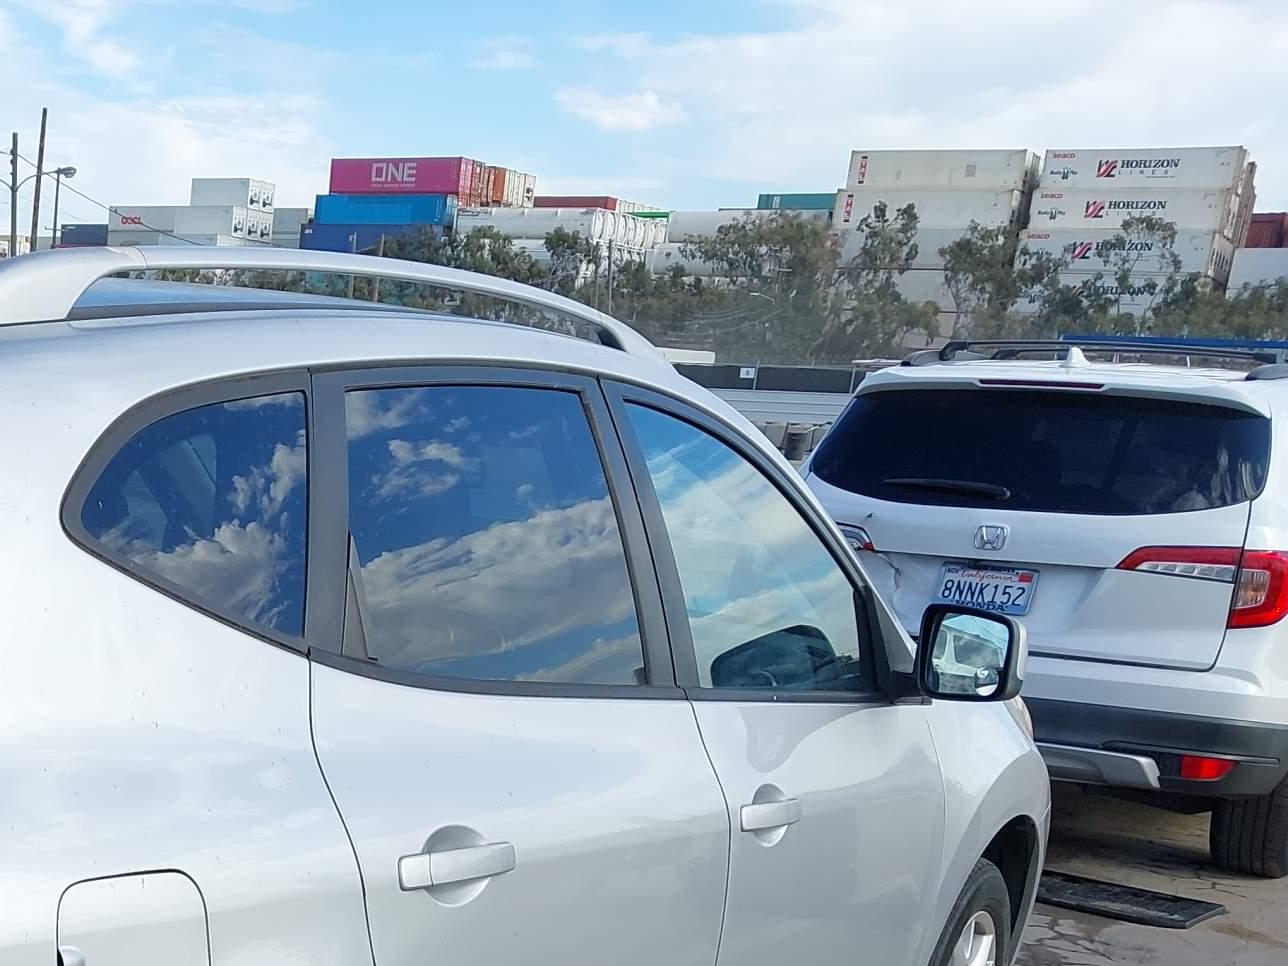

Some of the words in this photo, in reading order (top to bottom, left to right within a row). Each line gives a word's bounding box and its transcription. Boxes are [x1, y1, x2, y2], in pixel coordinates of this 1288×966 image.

[1120, 158, 1181, 169] HORIZON
[370, 162, 417, 182] ONE
[1108, 200, 1168, 210] HORIZON
[947, 567, 959, 575] NOV
[961, 567, 1013, 582] California
[941, 579, 1026, 607] 8NNK152
